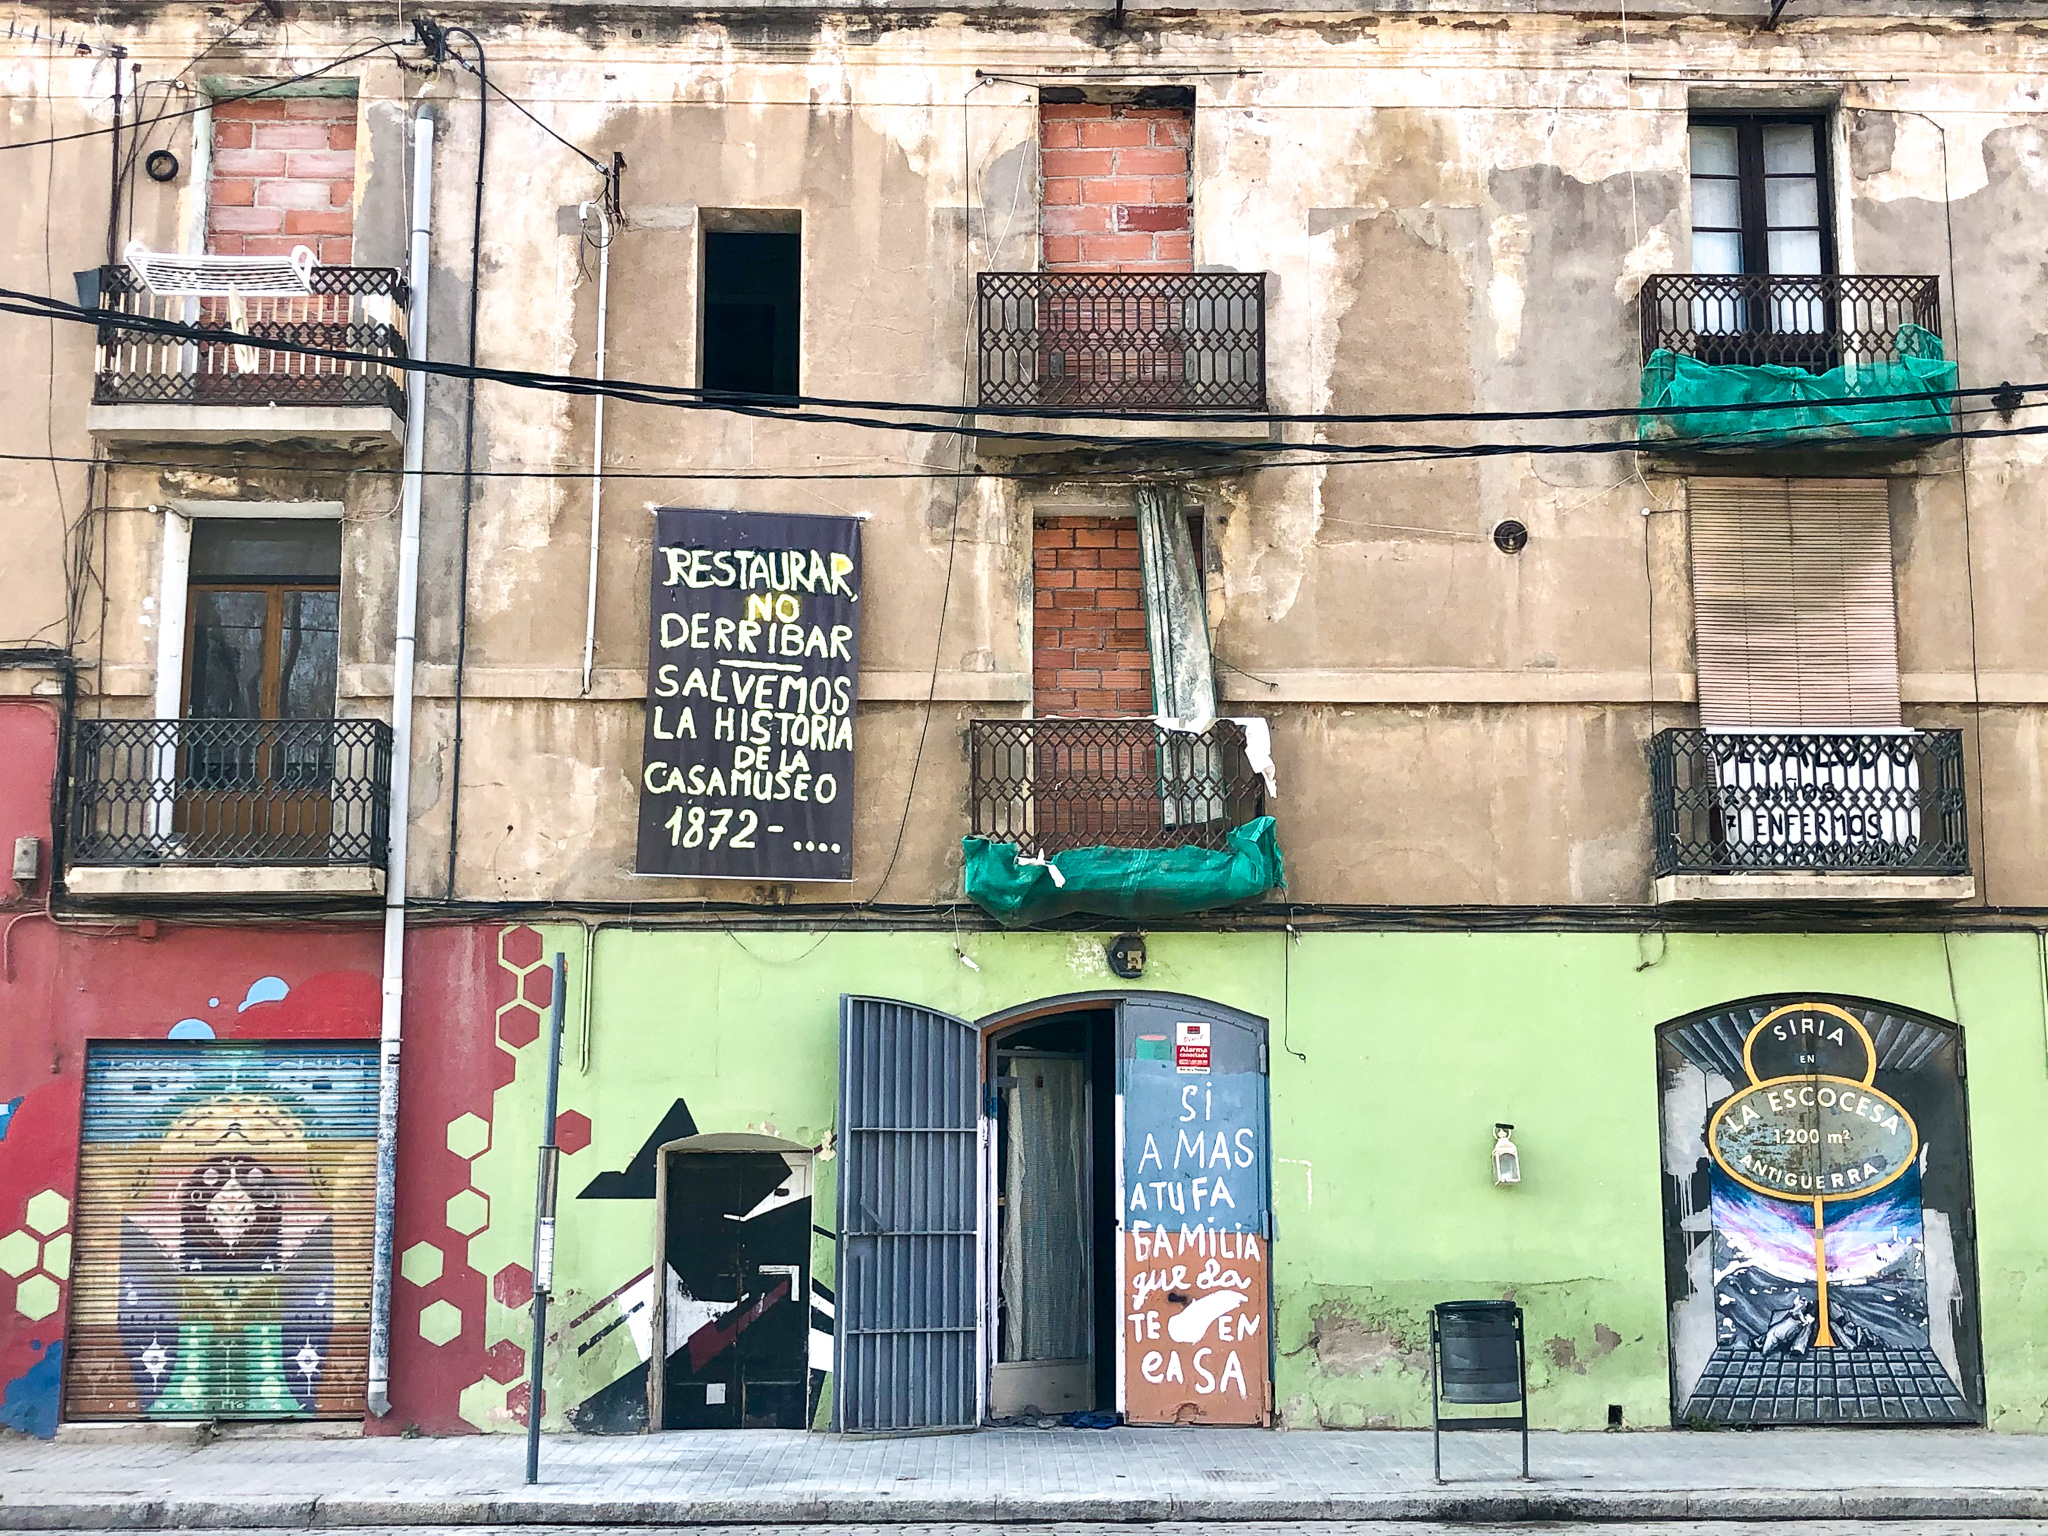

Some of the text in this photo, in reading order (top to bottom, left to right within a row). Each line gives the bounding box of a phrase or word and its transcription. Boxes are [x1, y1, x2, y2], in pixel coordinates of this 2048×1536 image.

[658, 547, 858, 603] RESTAURAR,
[748, 592, 800, 623] NO
[660, 612, 853, 662] DERRIBAR
[655, 664, 851, 716] SALVEMOS
[653, 706, 853, 751] LA HISTORIA
[734, 745, 810, 773] DE LA
[1755, 812, 1883, 839] ENFERMOS
[1773, 1017, 1845, 1046] SIRIA
[1799, 1054, 1815, 1064] EN
[1725, 1086, 1901, 1136] LA ESCOCESA
[1738, 1154, 1879, 1189] ANTIGUERRA
[1218, 1313, 1260, 1342] EN
